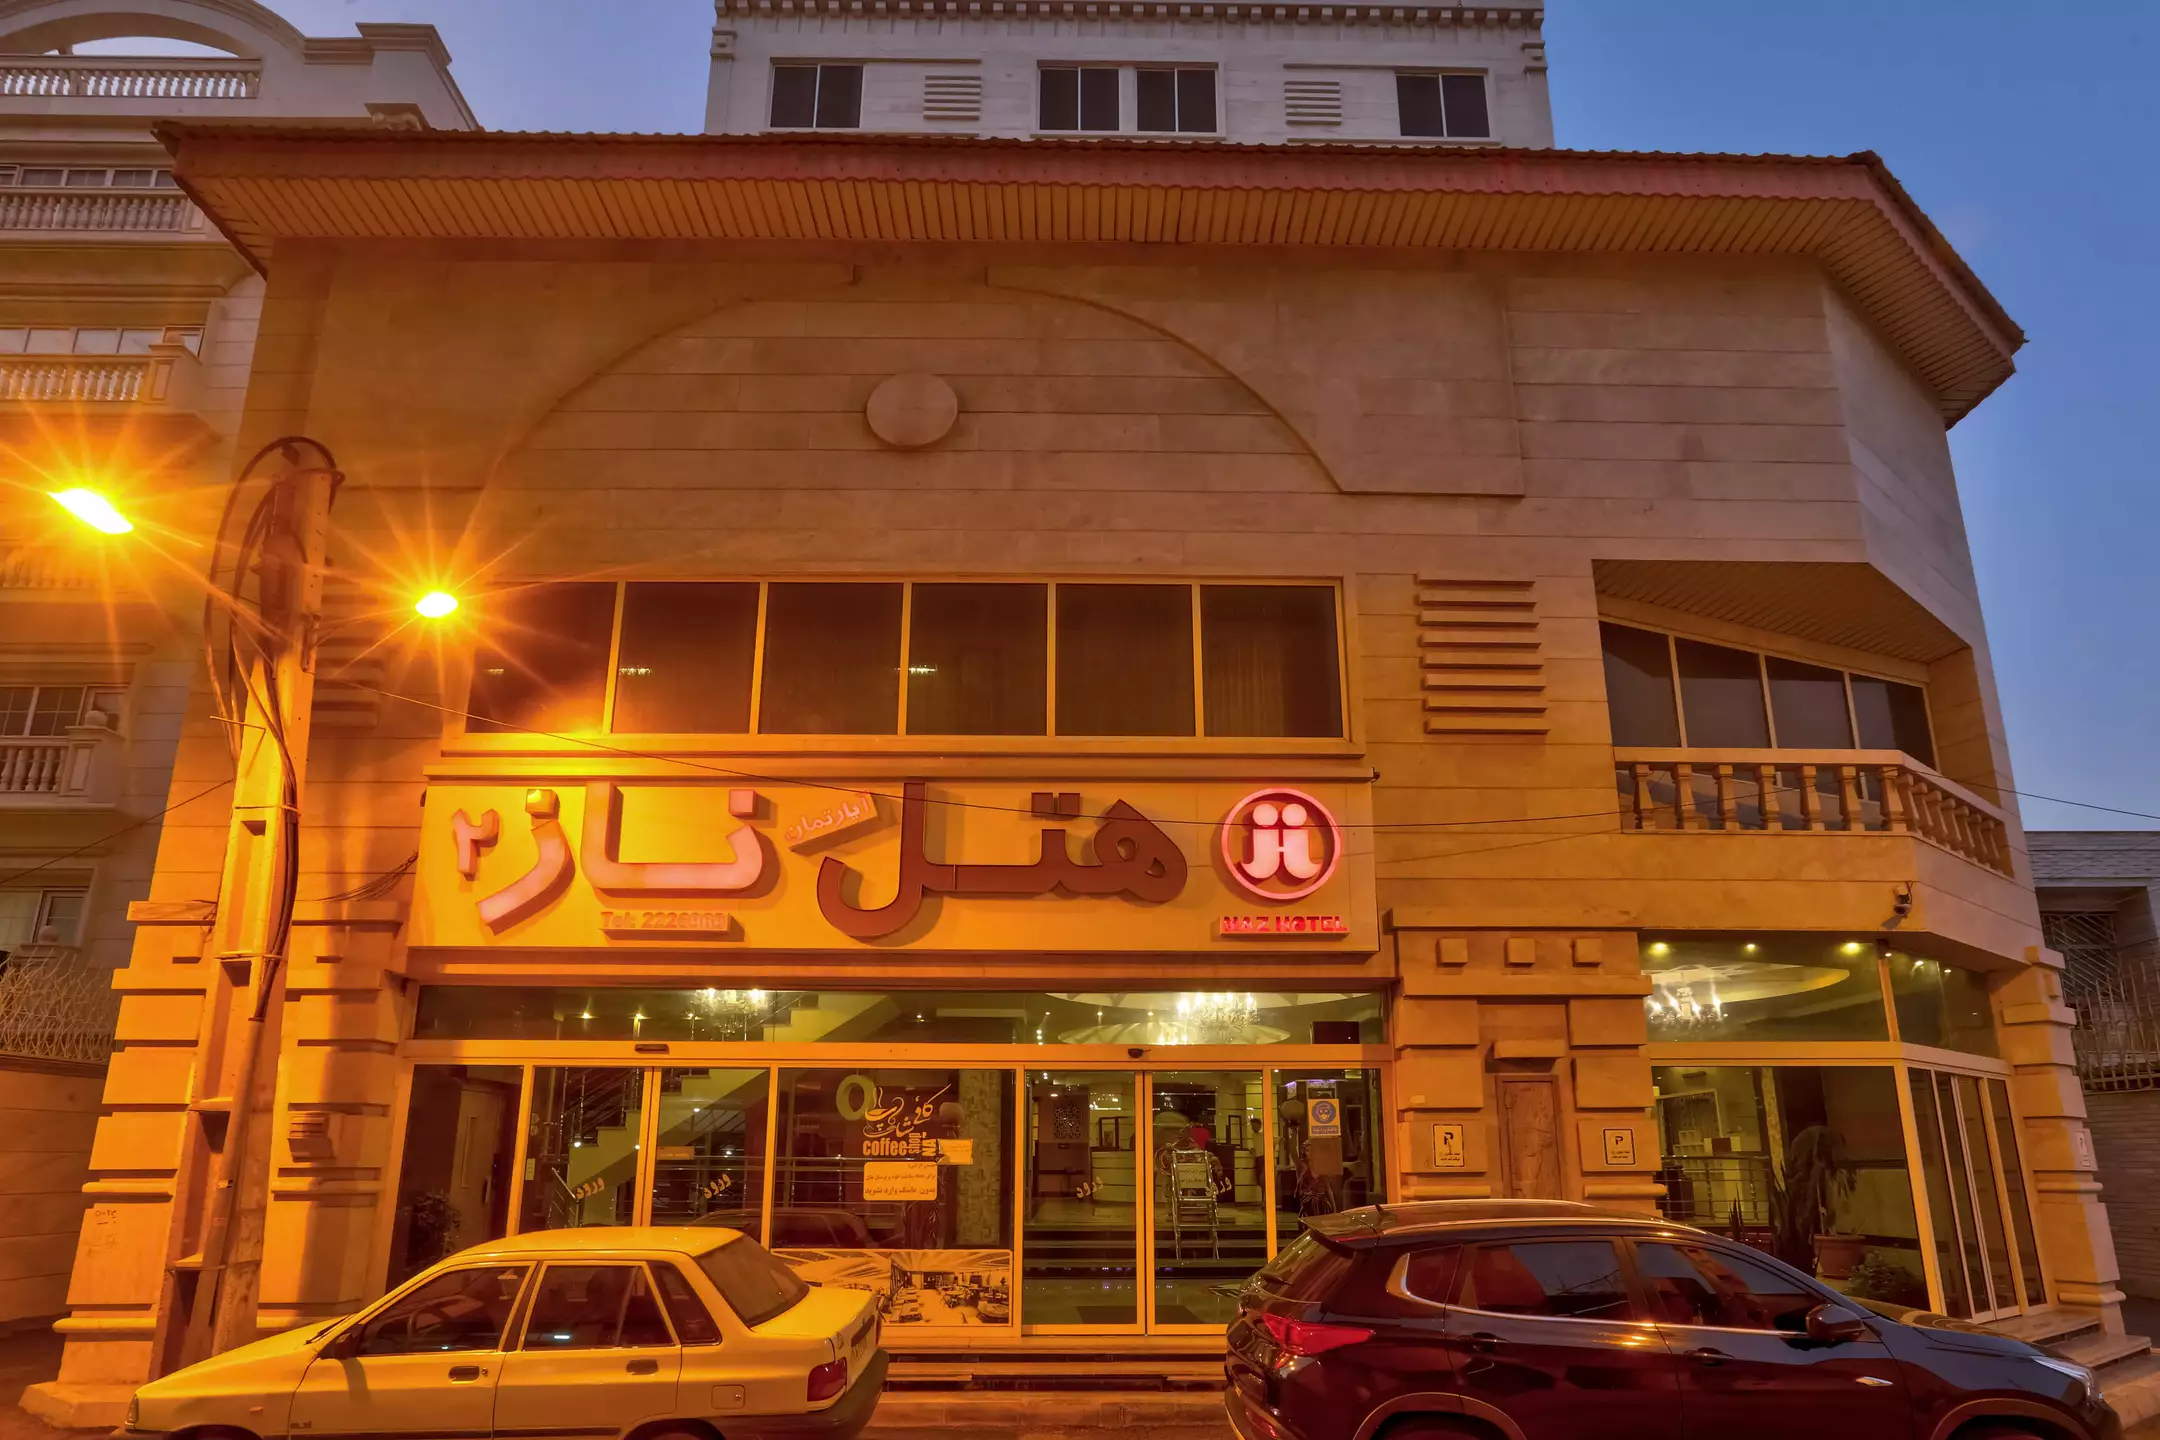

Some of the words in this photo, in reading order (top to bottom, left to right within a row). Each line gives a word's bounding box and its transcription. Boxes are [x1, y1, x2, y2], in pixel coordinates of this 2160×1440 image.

[784, 788, 871, 842] آپارتمان
[452, 808, 499, 876] ۲
[475, 782, 764, 930] ناز
[816, 783, 1188, 938] هتل
[1223, 916, 1270, 932] NAZ
[1275, 916, 1348, 932] HOTEL
[862, 1138, 908, 1156] coffee
[908, 1132, 921, 1155] shop
[576, 1177, 605, 1200] ورود
